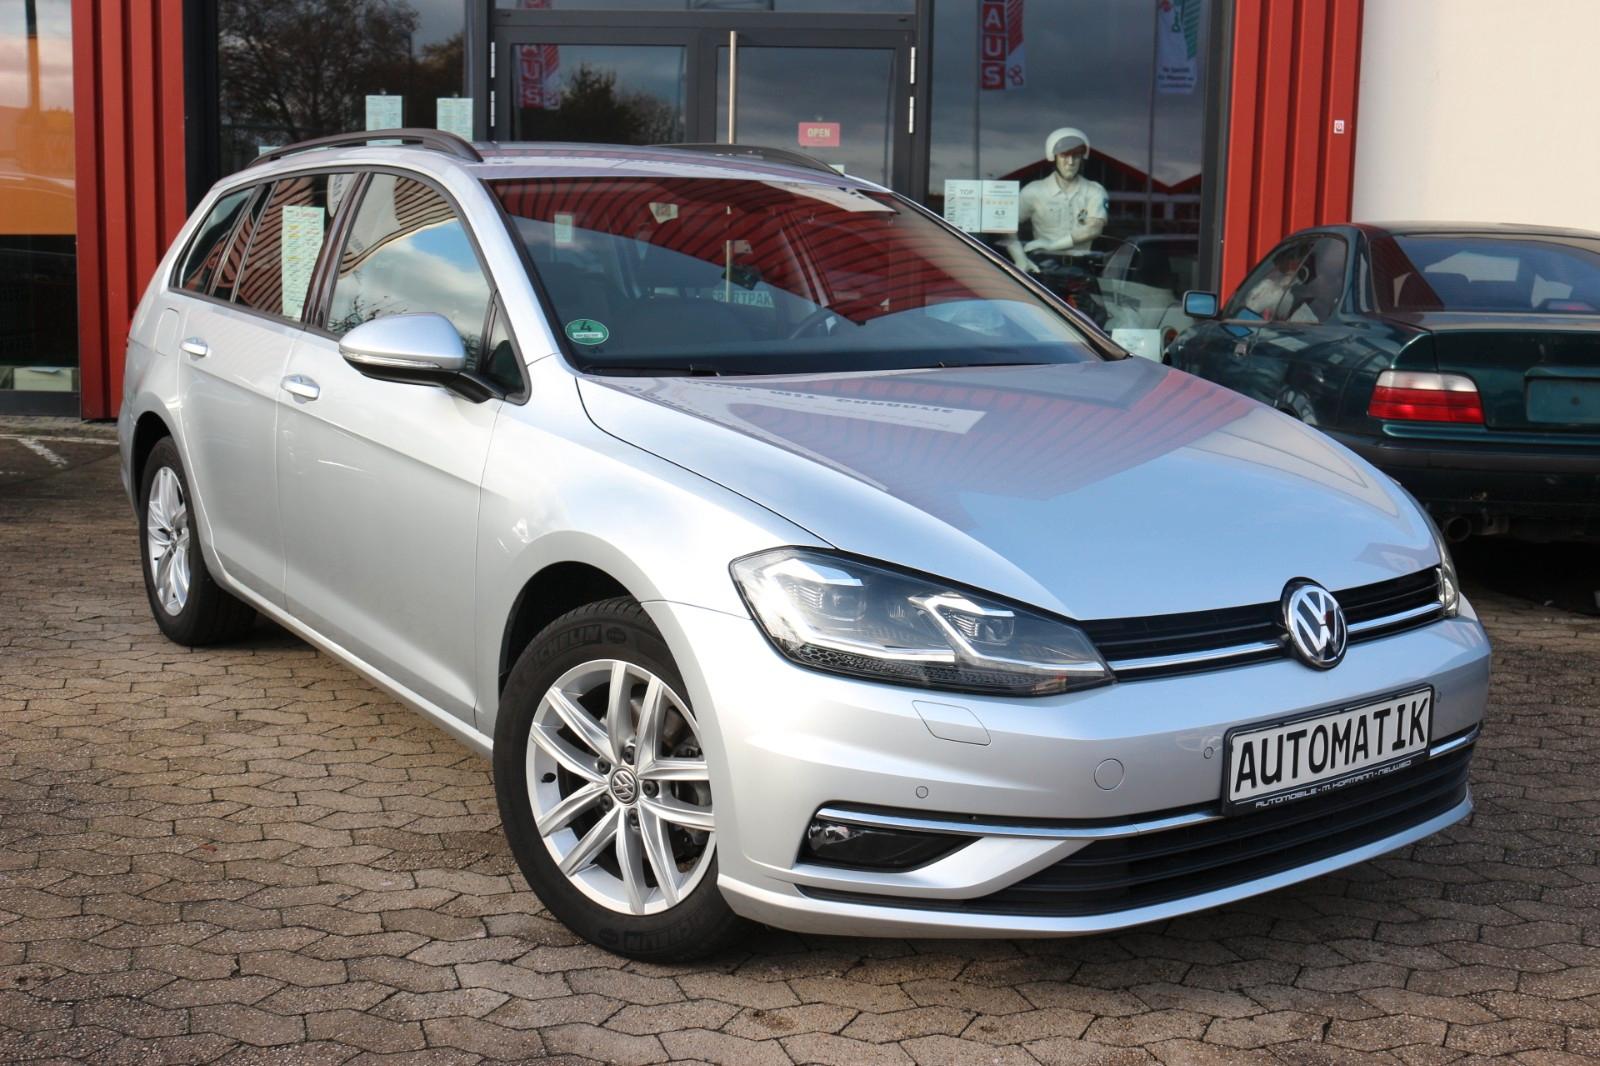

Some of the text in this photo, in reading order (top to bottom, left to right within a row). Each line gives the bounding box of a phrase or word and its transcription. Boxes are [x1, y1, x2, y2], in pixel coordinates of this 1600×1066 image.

[807, 127, 831, 137] OPEN
[1234, 697, 1429, 793] AUTOMATIK
[1255, 788, 1317, 808] AUTOMOBILE
[1332, 771, 1375, 789] HOFMANN
